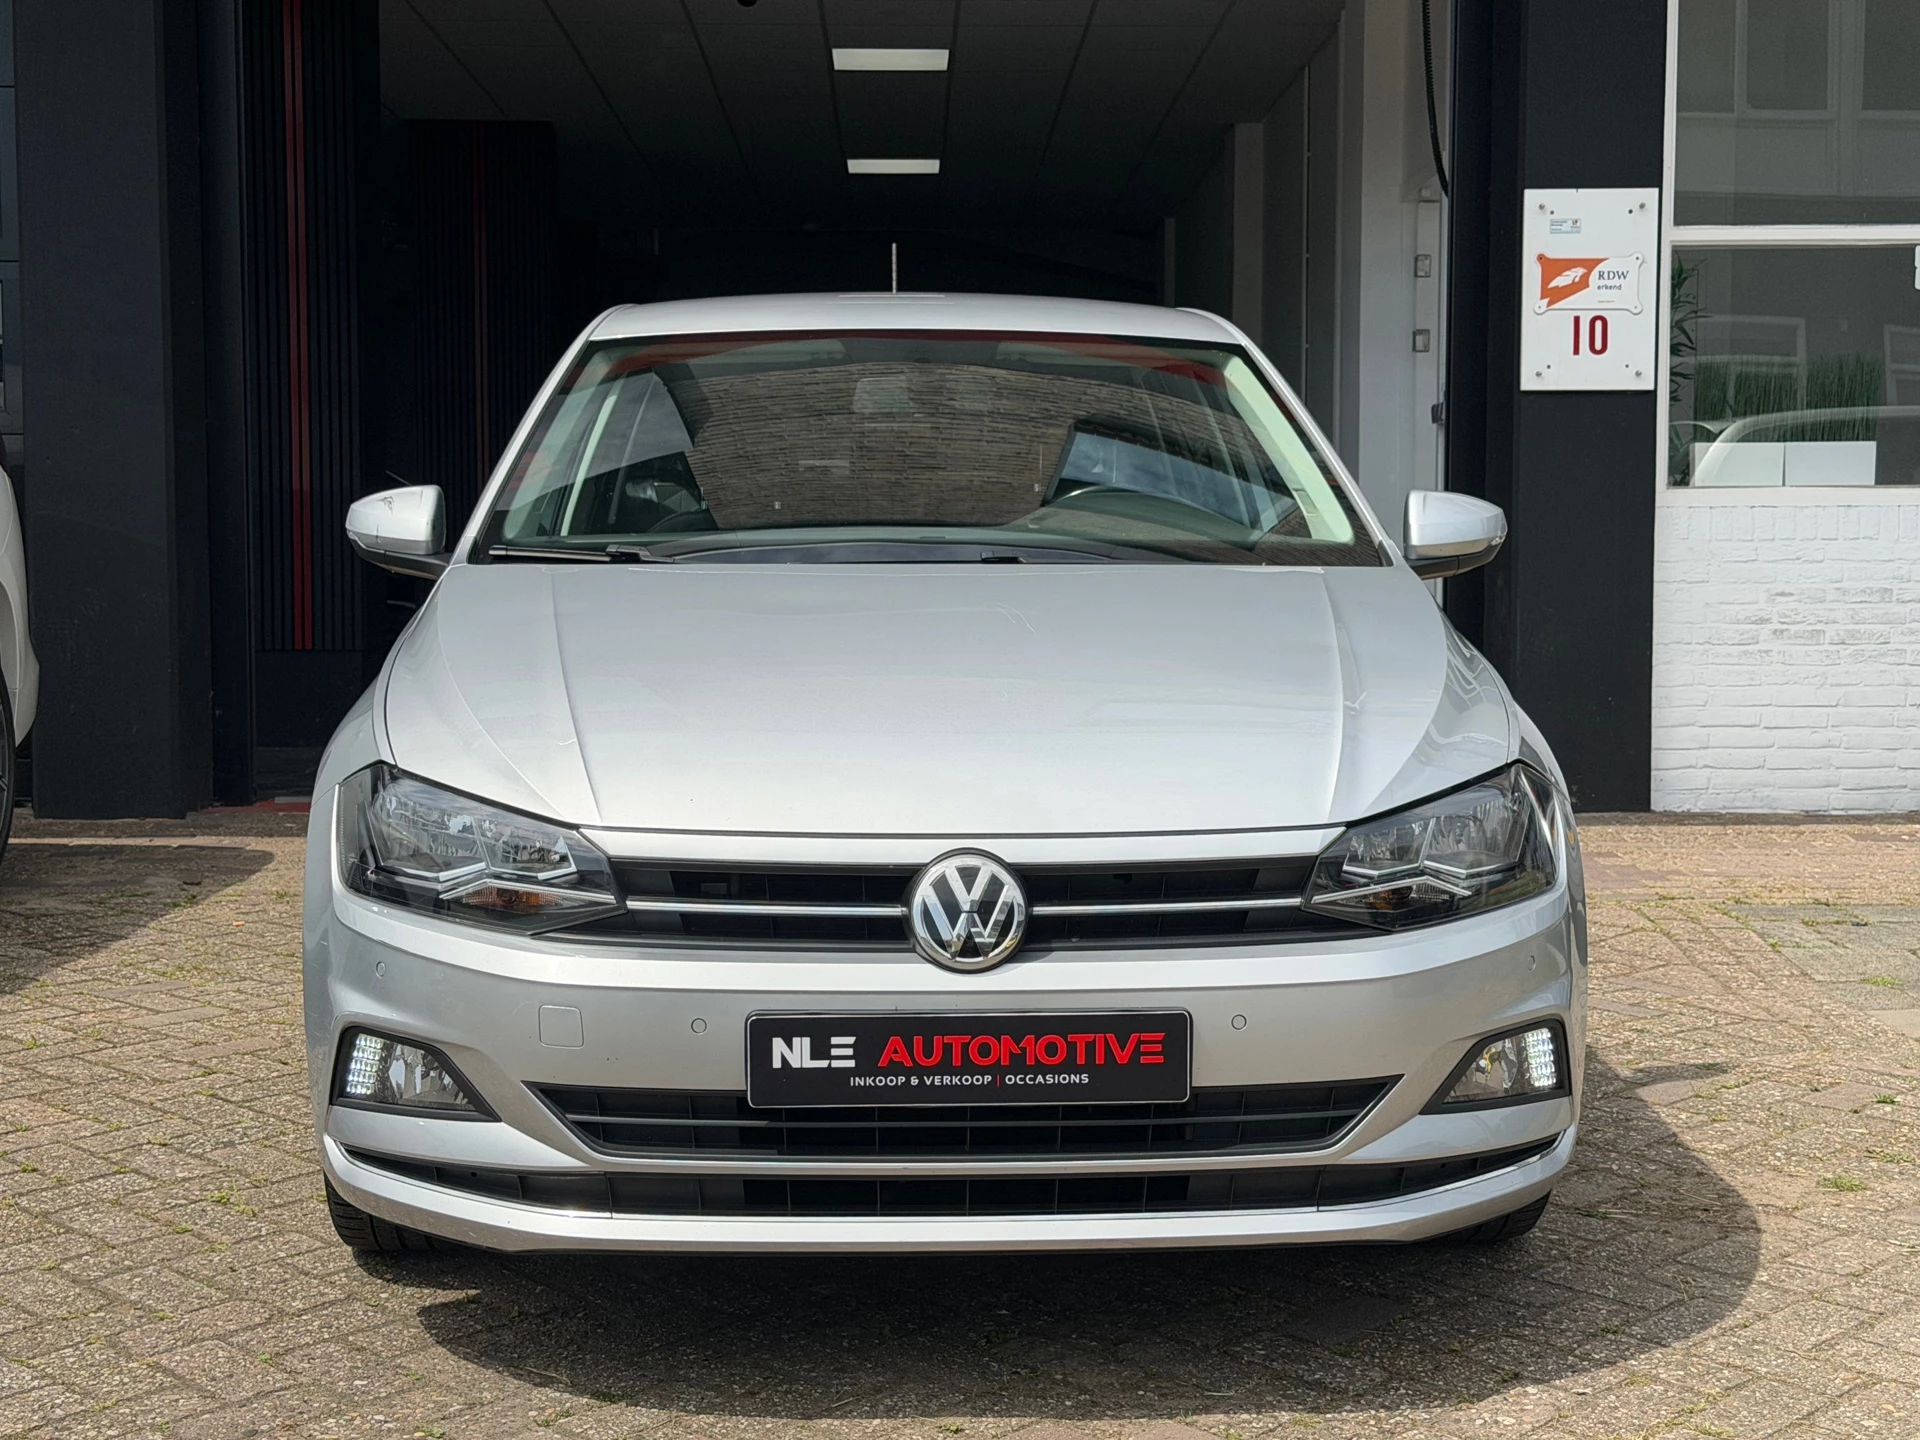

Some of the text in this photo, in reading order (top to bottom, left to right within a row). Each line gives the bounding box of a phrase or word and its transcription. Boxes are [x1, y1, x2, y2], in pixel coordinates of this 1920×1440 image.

[1597, 270, 1629, 281] RDW
[1573, 315, 1608, 356] 10
[772, 1033, 1165, 1068] NLE AUTOMOTIVE
[850, 1074, 1089, 1087] INKOOP & VERKOOP OCCASIONS
